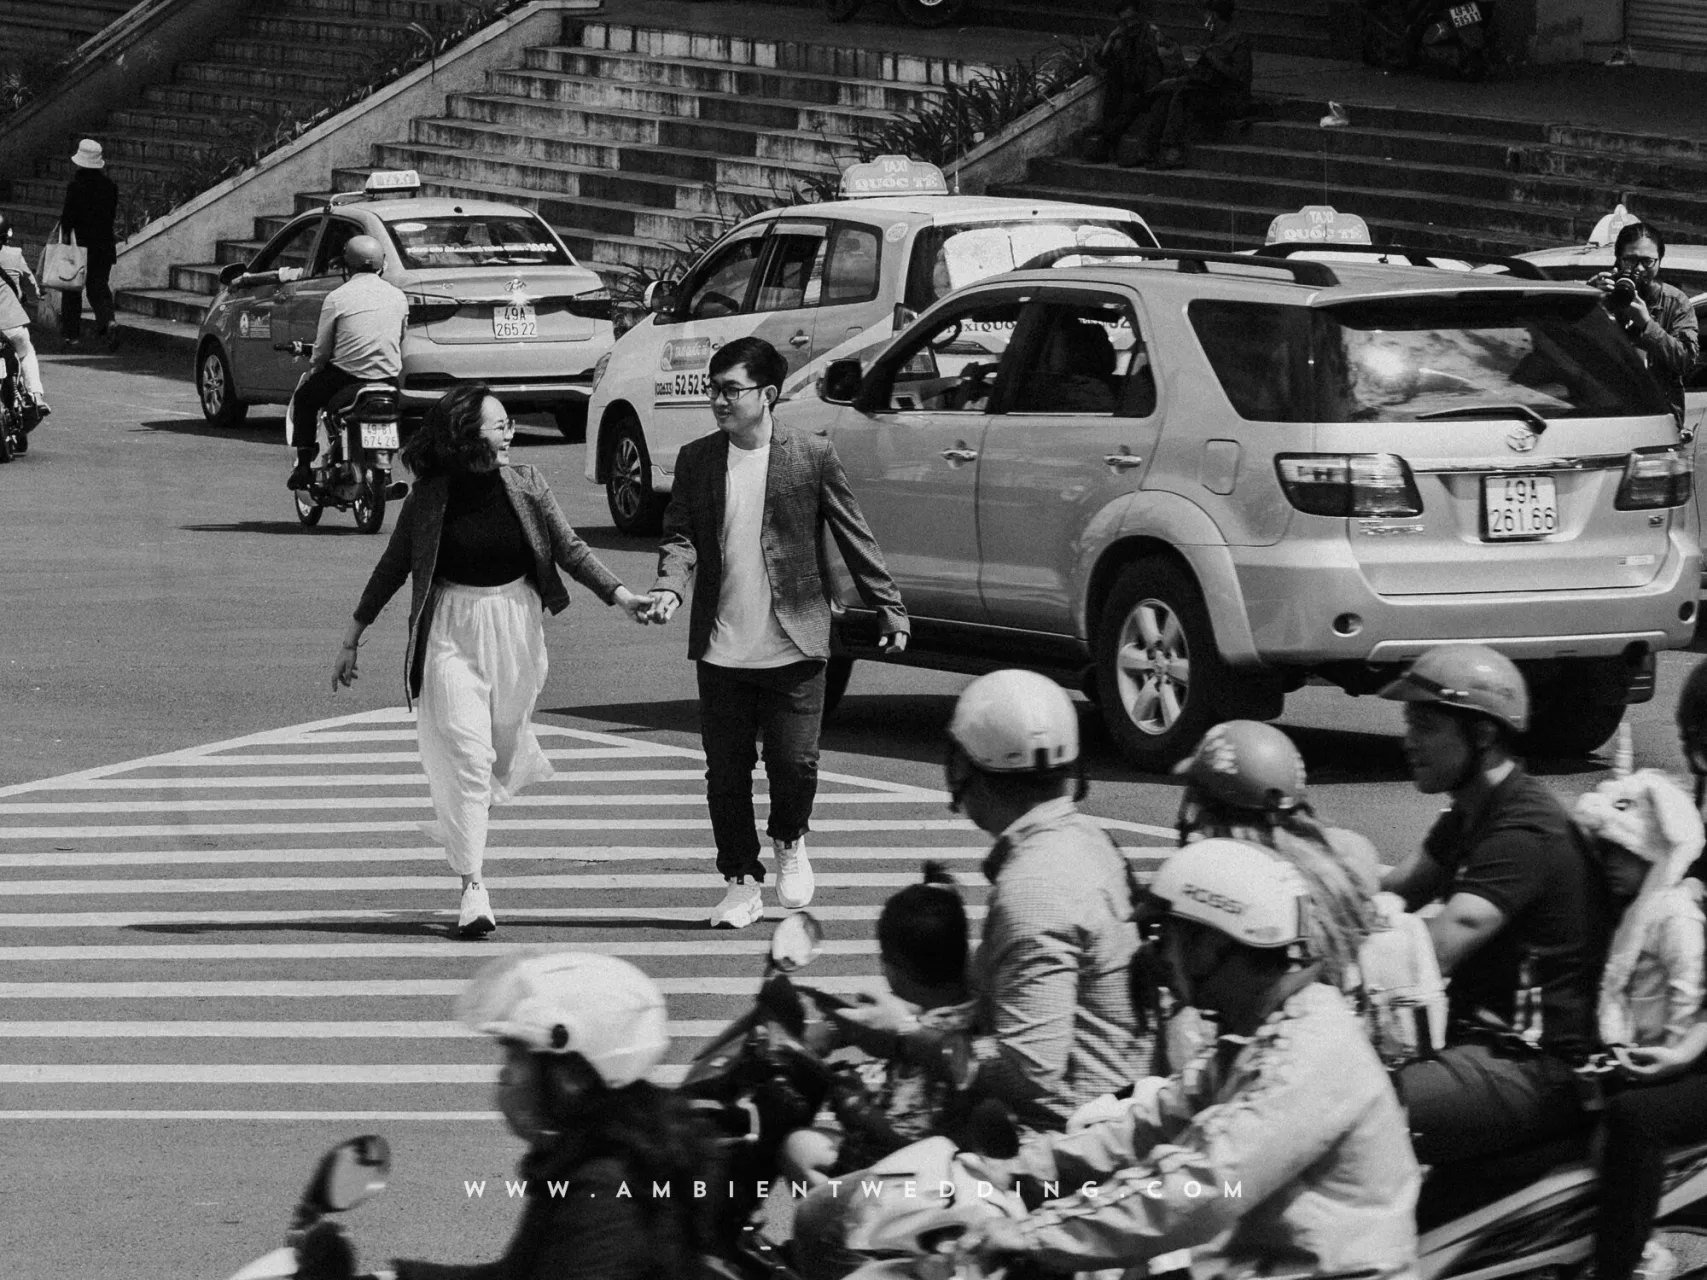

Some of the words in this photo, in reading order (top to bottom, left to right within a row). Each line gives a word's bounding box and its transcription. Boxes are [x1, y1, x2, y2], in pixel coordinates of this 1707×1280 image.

[884, 161, 908, 173] TAXI
[505, 307, 526, 321] 49A
[1506, 480, 1538, 503] 49A
